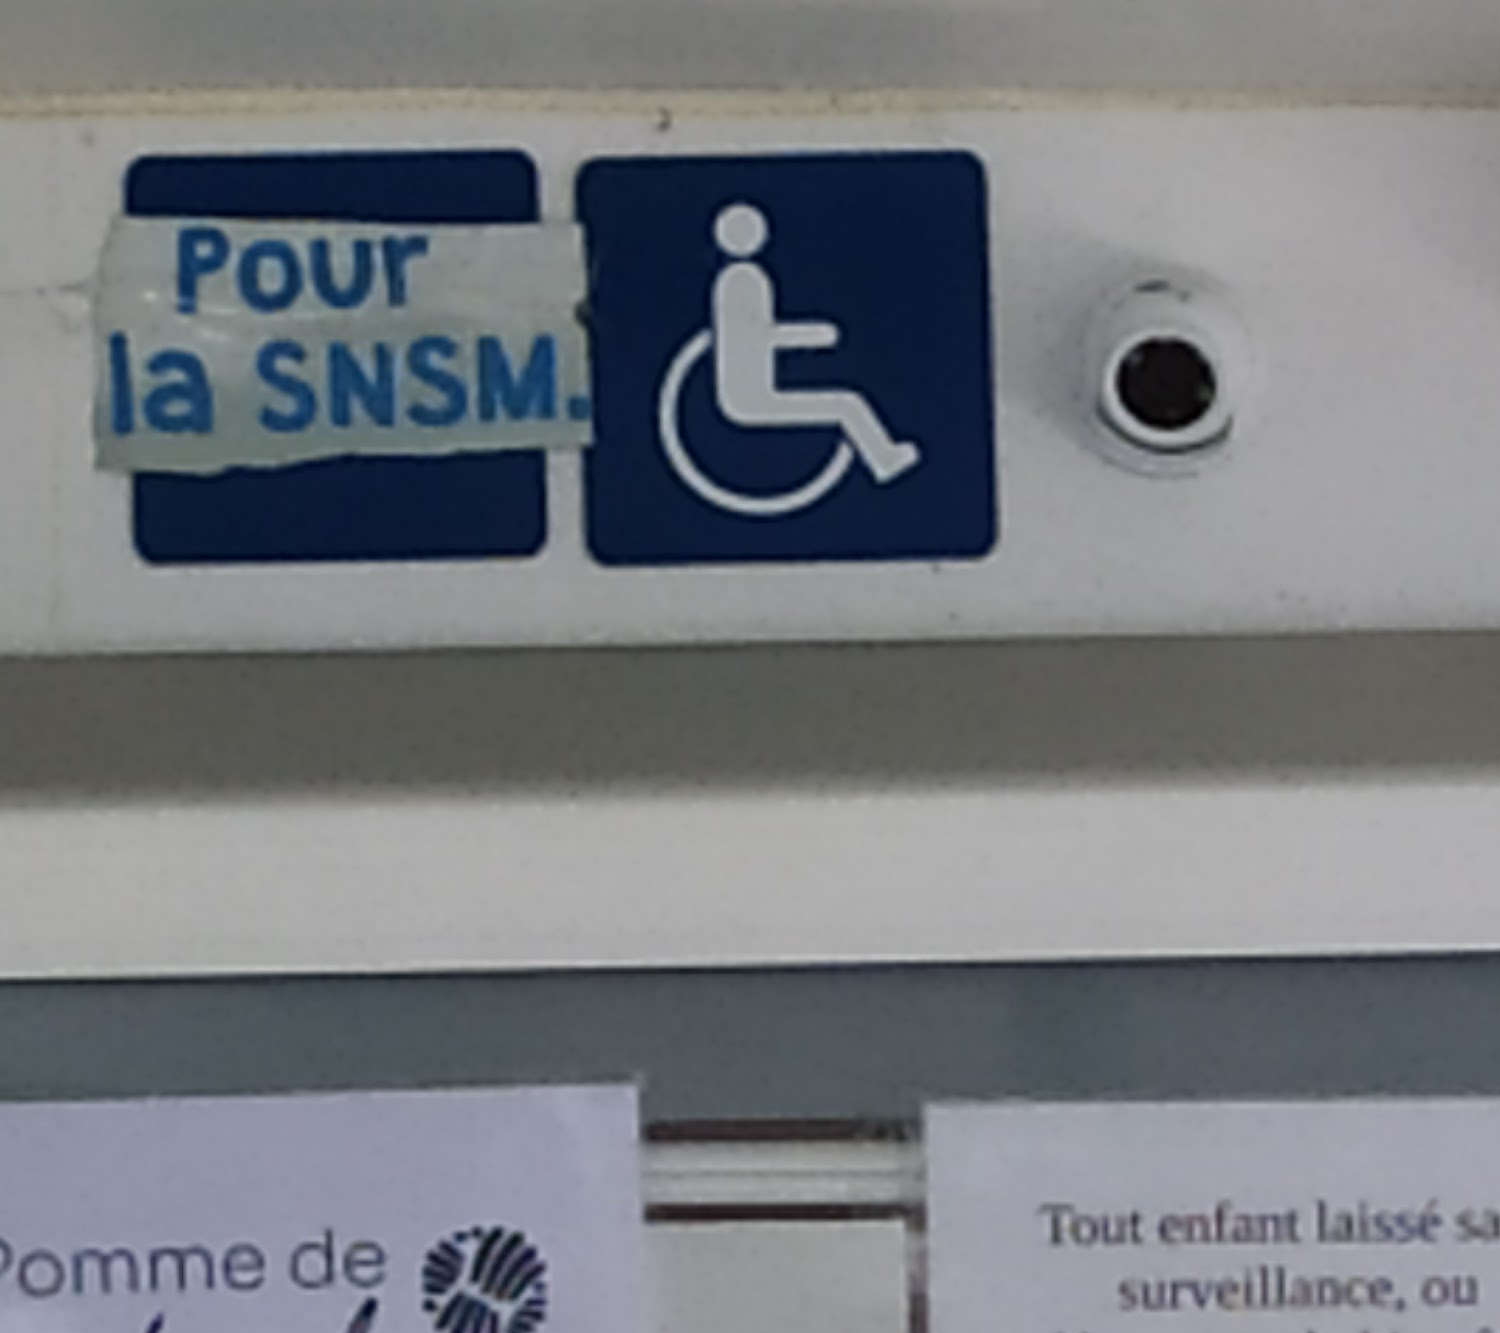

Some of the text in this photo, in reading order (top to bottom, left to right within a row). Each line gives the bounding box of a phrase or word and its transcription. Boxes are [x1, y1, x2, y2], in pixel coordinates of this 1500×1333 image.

[176, 227, 428, 313] Pour
[109, 332, 592, 435] la SNSM.
[1036, 1203, 1143, 1245] Tout
[1158, 1201, 1300, 1244] enfant
[1316, 1199, 1441, 1243] laissé
[290, 1228, 387, 1290] de
[1118, 1266, 1479, 1311] surveillance, ou
